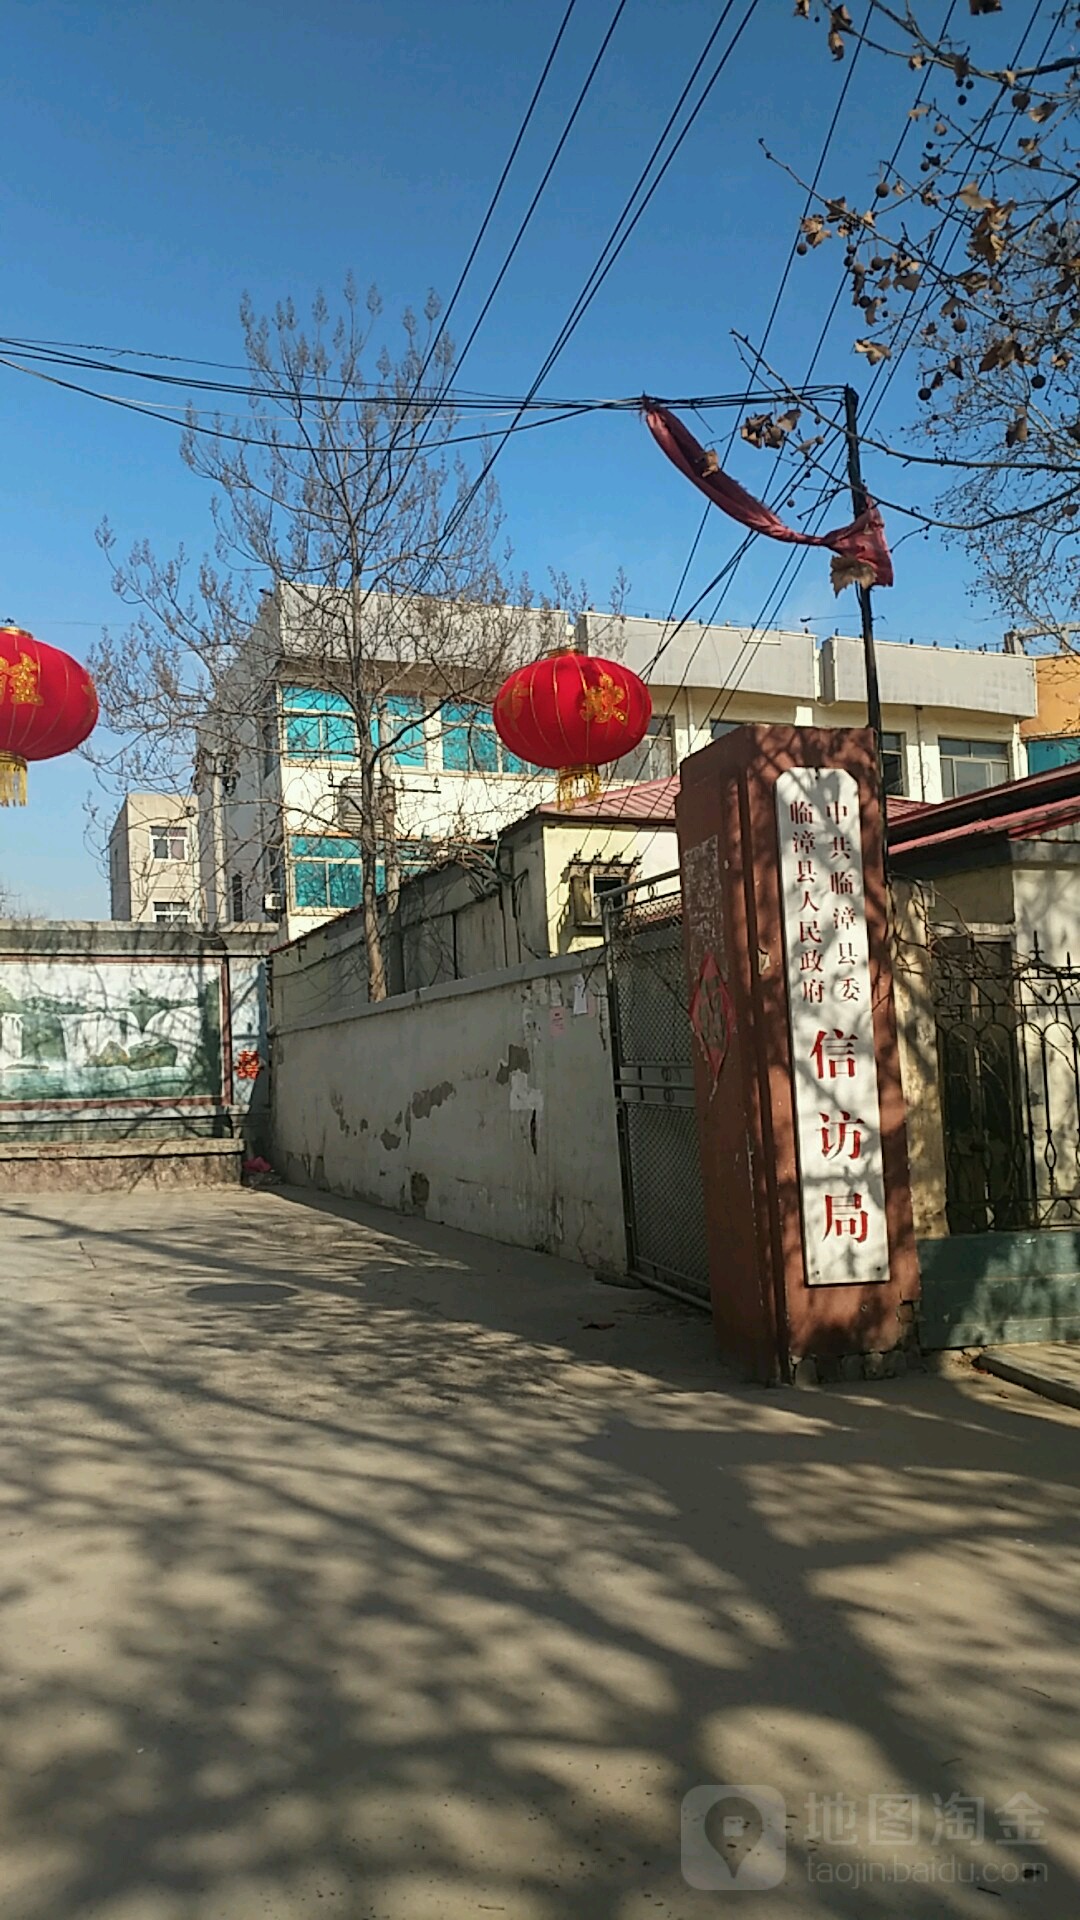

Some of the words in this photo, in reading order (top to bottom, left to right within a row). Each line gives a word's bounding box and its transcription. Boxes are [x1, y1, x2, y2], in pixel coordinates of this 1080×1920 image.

[789, 799, 826, 1005] 临漳县人民政府
[825, 801, 861, 1004] 中共临漳县委
[809, 1027, 869, 1245] 信访局
